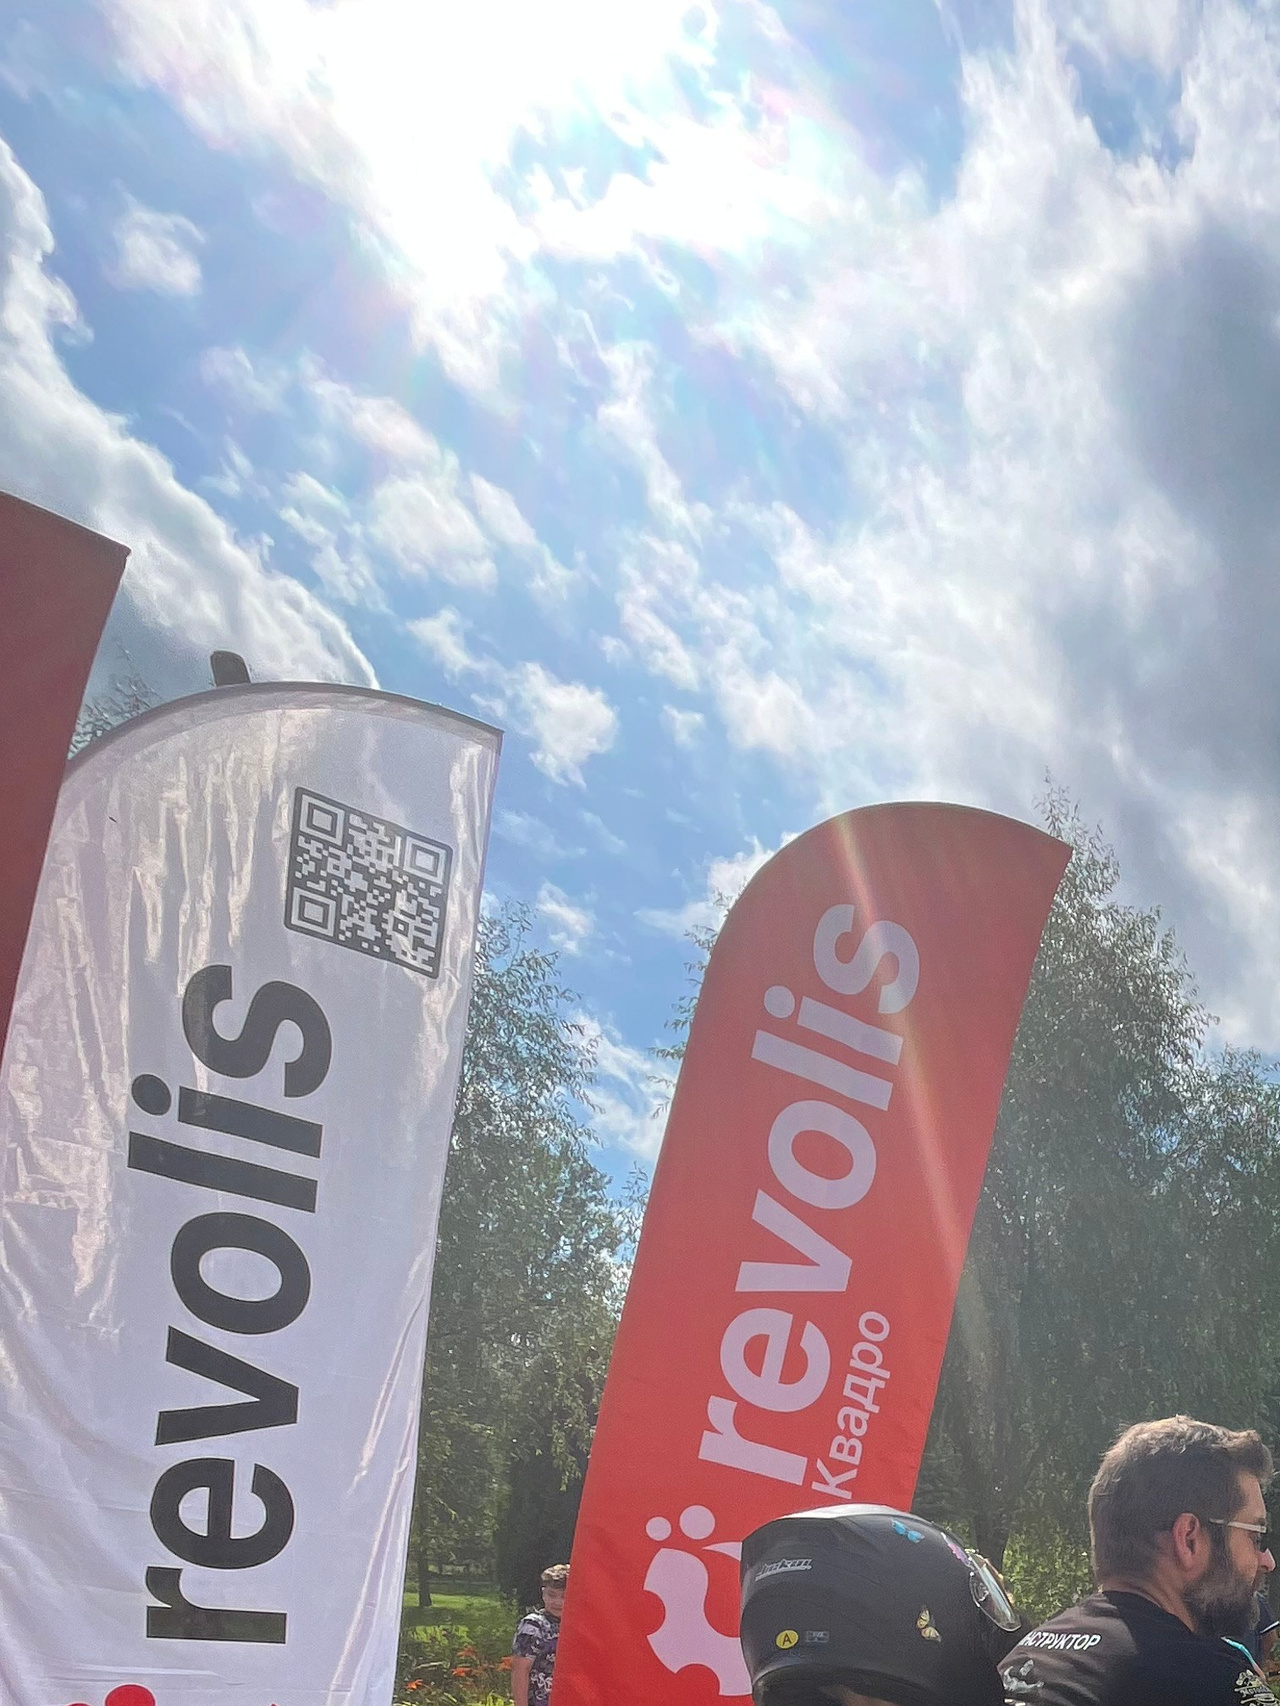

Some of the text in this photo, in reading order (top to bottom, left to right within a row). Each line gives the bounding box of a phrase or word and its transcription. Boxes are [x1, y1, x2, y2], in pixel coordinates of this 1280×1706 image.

[128, 964, 332, 1645] revolis
[697, 903, 920, 1486] revolis
[811, 1310, 891, 1499] Квадро
[1018, 1631, 1102, 1650] НСТРУКТОР
